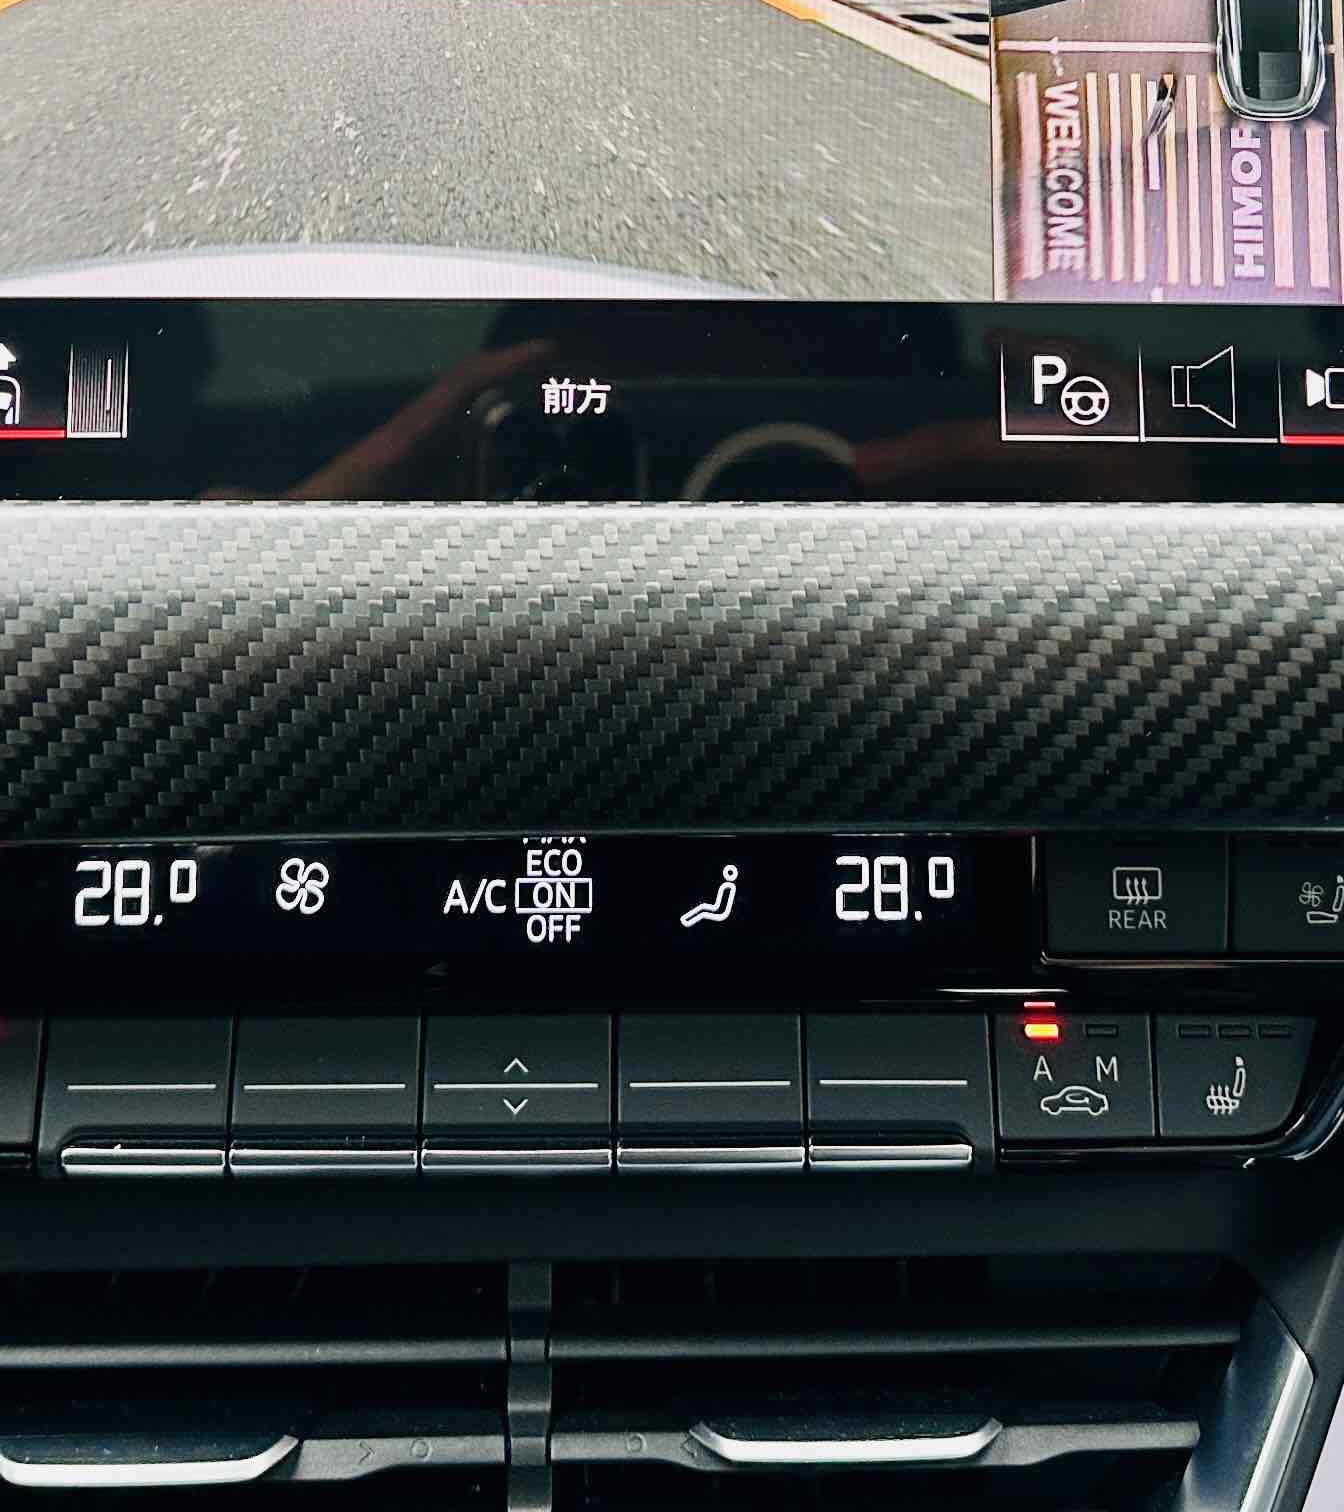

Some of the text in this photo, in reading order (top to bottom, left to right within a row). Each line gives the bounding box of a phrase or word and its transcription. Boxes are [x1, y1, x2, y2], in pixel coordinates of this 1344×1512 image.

[1045, 81, 1086, 271] WELCOME
[542, 377, 612, 415] 前方
[526, 849, 583, 876] ECO
[443, 878, 507, 914] A/C
[532, 882, 576, 908] ON
[526, 914, 582, 943] OFF
[1108, 909, 1167, 929] REAR
[1033, 1055, 1119, 1082] A M
